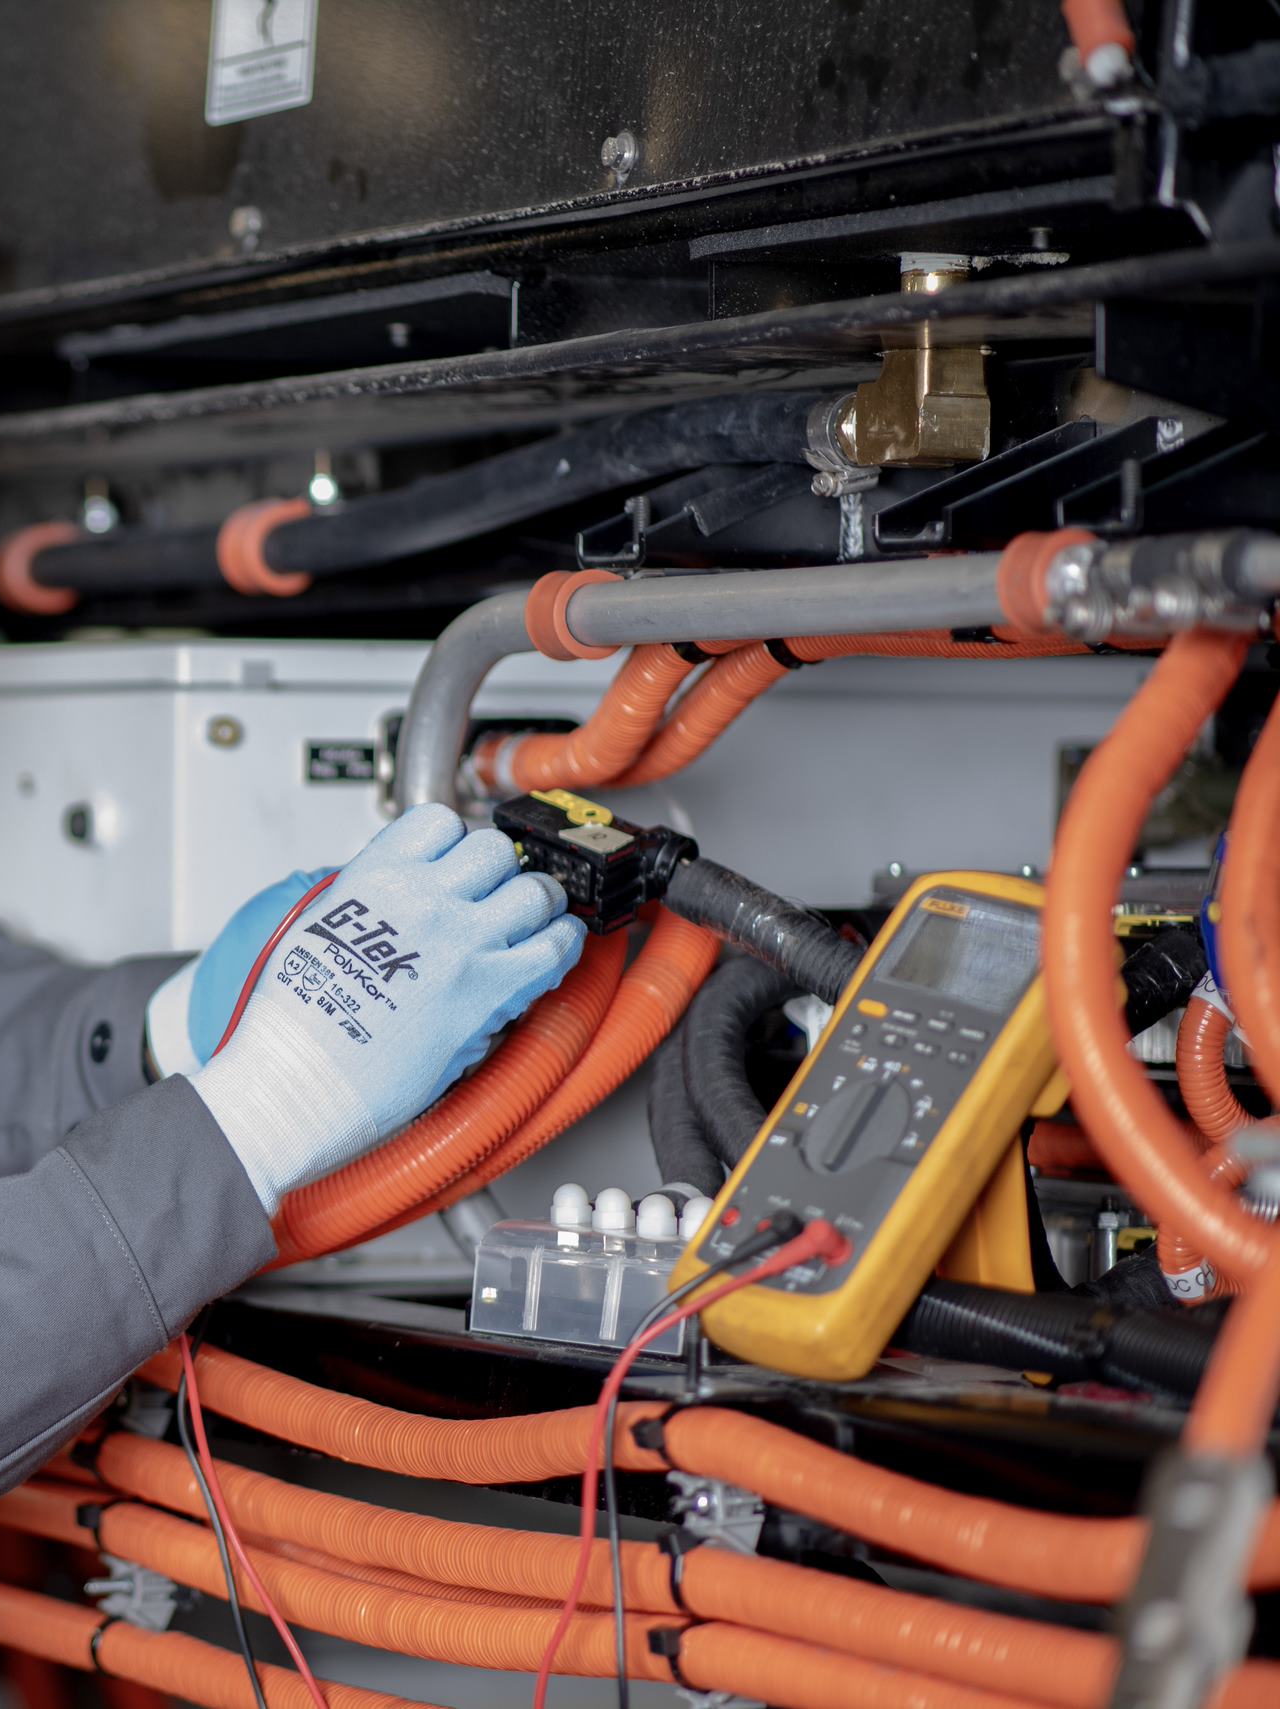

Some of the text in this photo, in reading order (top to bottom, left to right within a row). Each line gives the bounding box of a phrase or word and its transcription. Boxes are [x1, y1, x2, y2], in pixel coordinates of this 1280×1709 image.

[287, 959, 300, 971] A2
[277, 972, 312, 1005] CUT 4342
[331, 983, 361, 1014] 16-322
[316, 996, 337, 1016] 8/M
